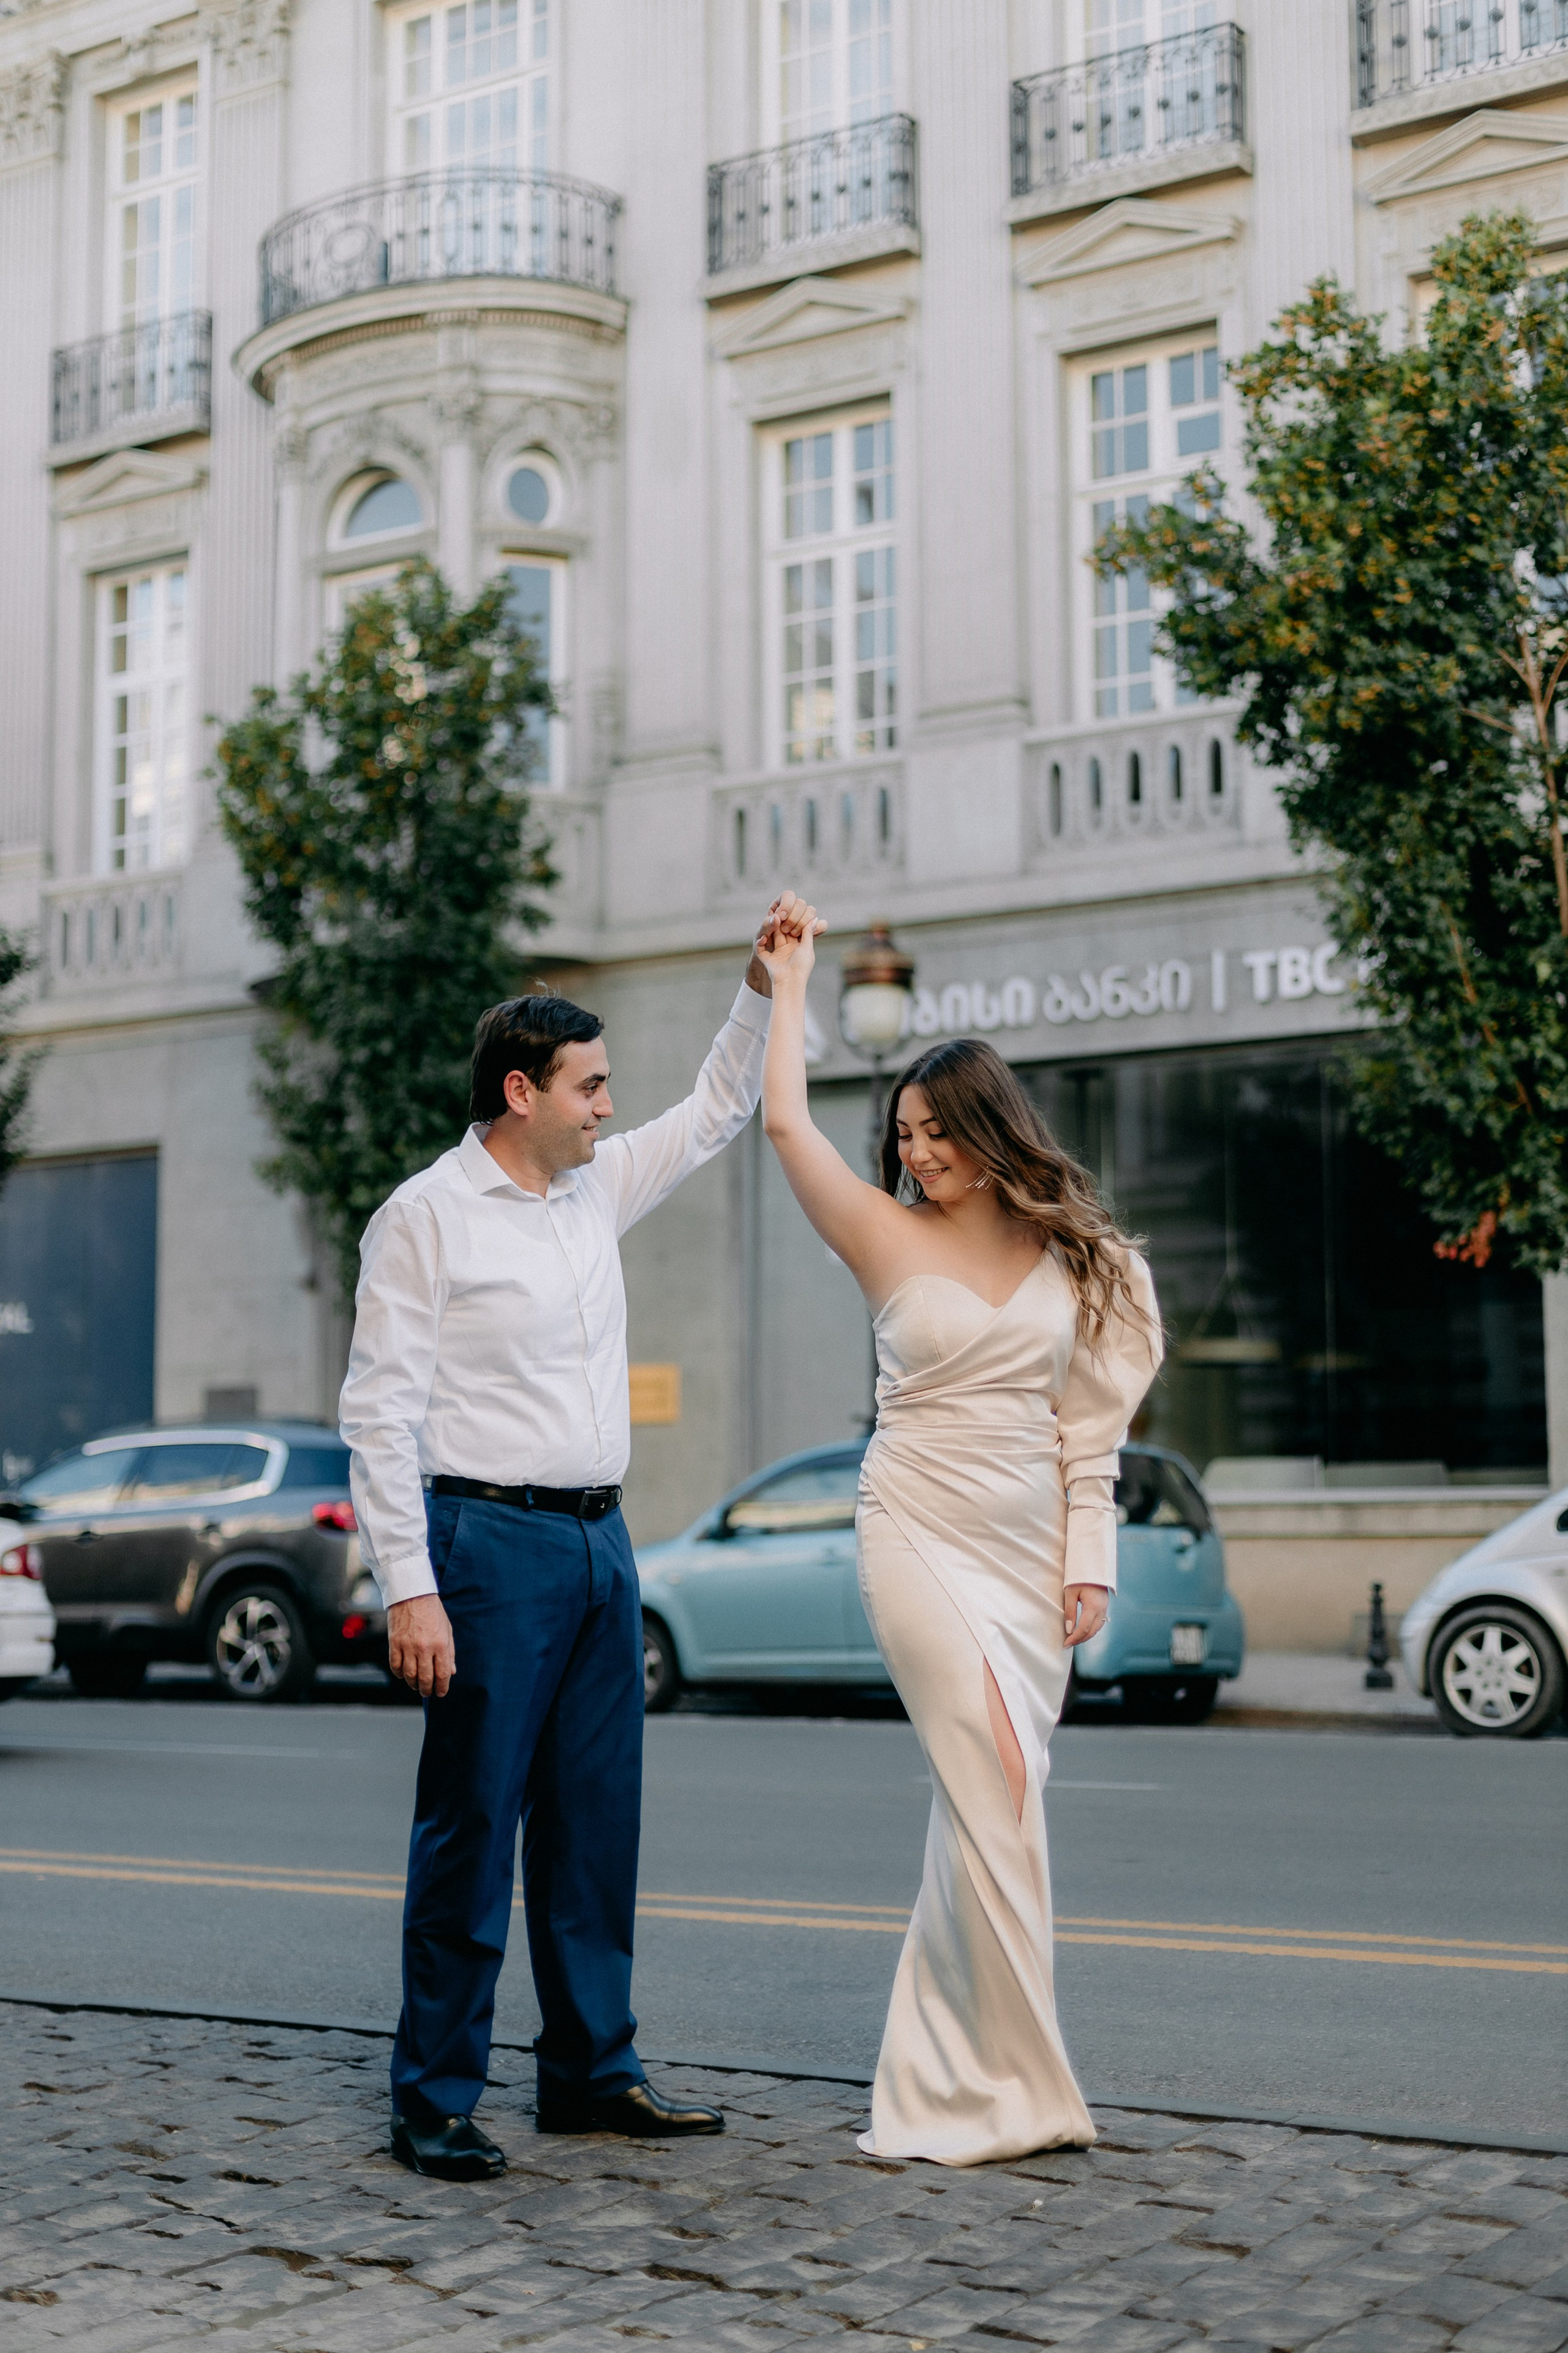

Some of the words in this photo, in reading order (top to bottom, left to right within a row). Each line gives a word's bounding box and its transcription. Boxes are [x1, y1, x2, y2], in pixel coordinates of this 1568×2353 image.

[844, 976, 1036, 1039] ბისი
[1042, 957, 1192, 1024] ბანკი
[1242, 941, 1346, 1003] TBC
